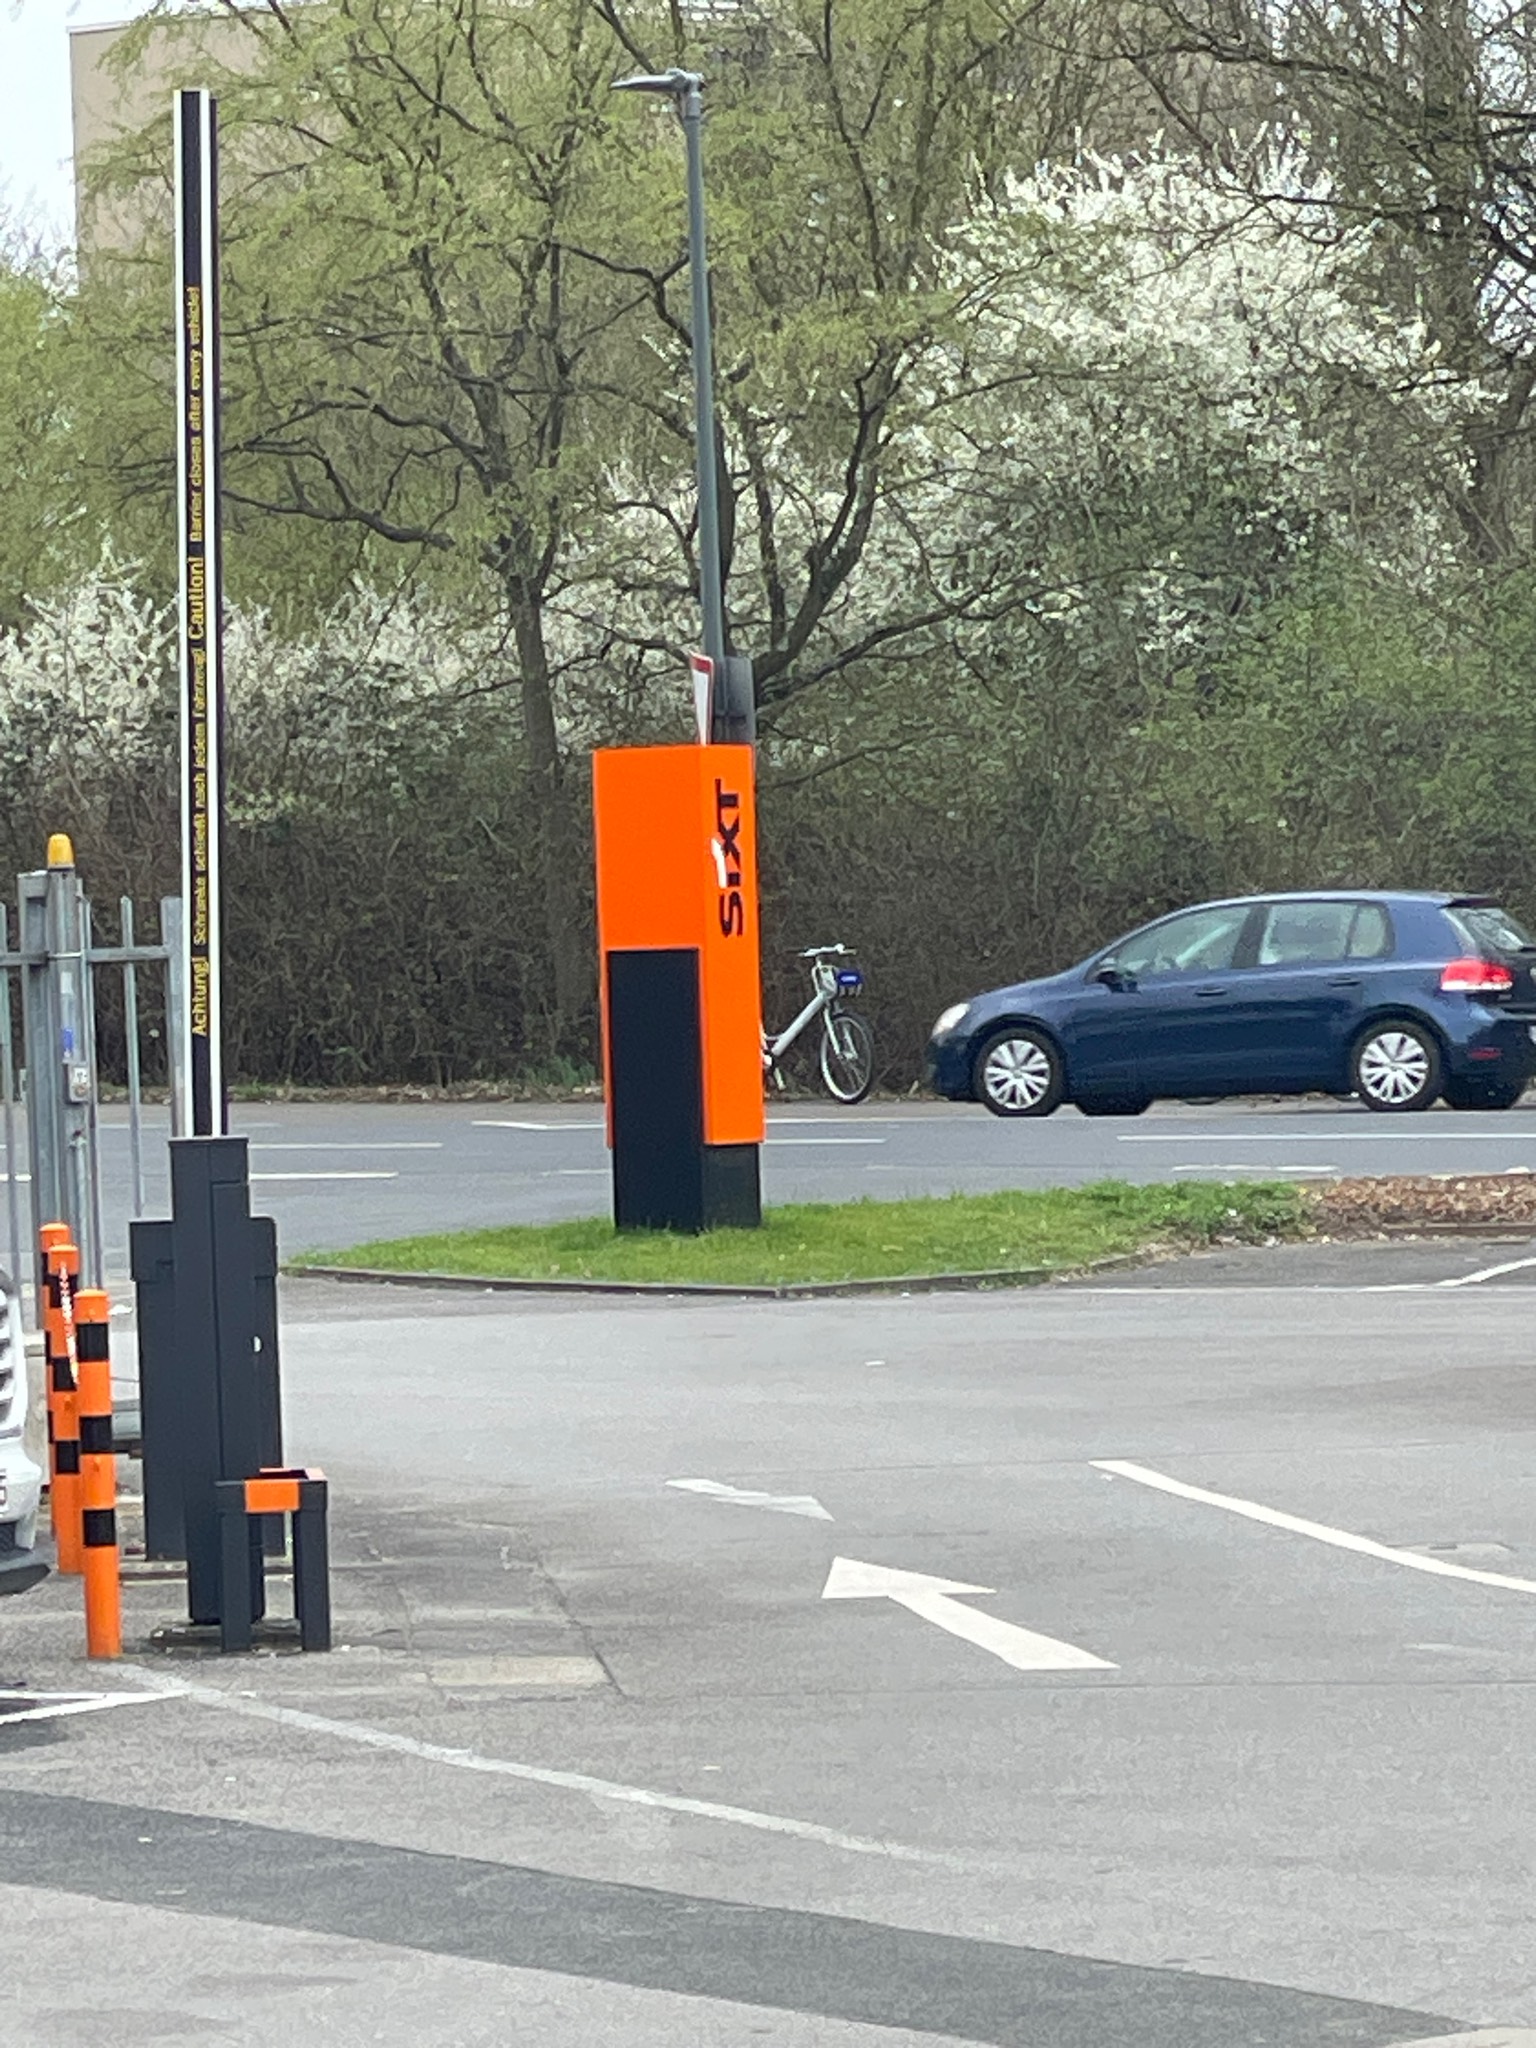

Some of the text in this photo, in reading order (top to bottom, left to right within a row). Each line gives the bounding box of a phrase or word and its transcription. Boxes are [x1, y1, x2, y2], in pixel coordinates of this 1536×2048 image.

[191, 491, 204, 542] Barrier
[190, 557, 205, 639] Caution!
[192, 956, 209, 1036] Achtung!
